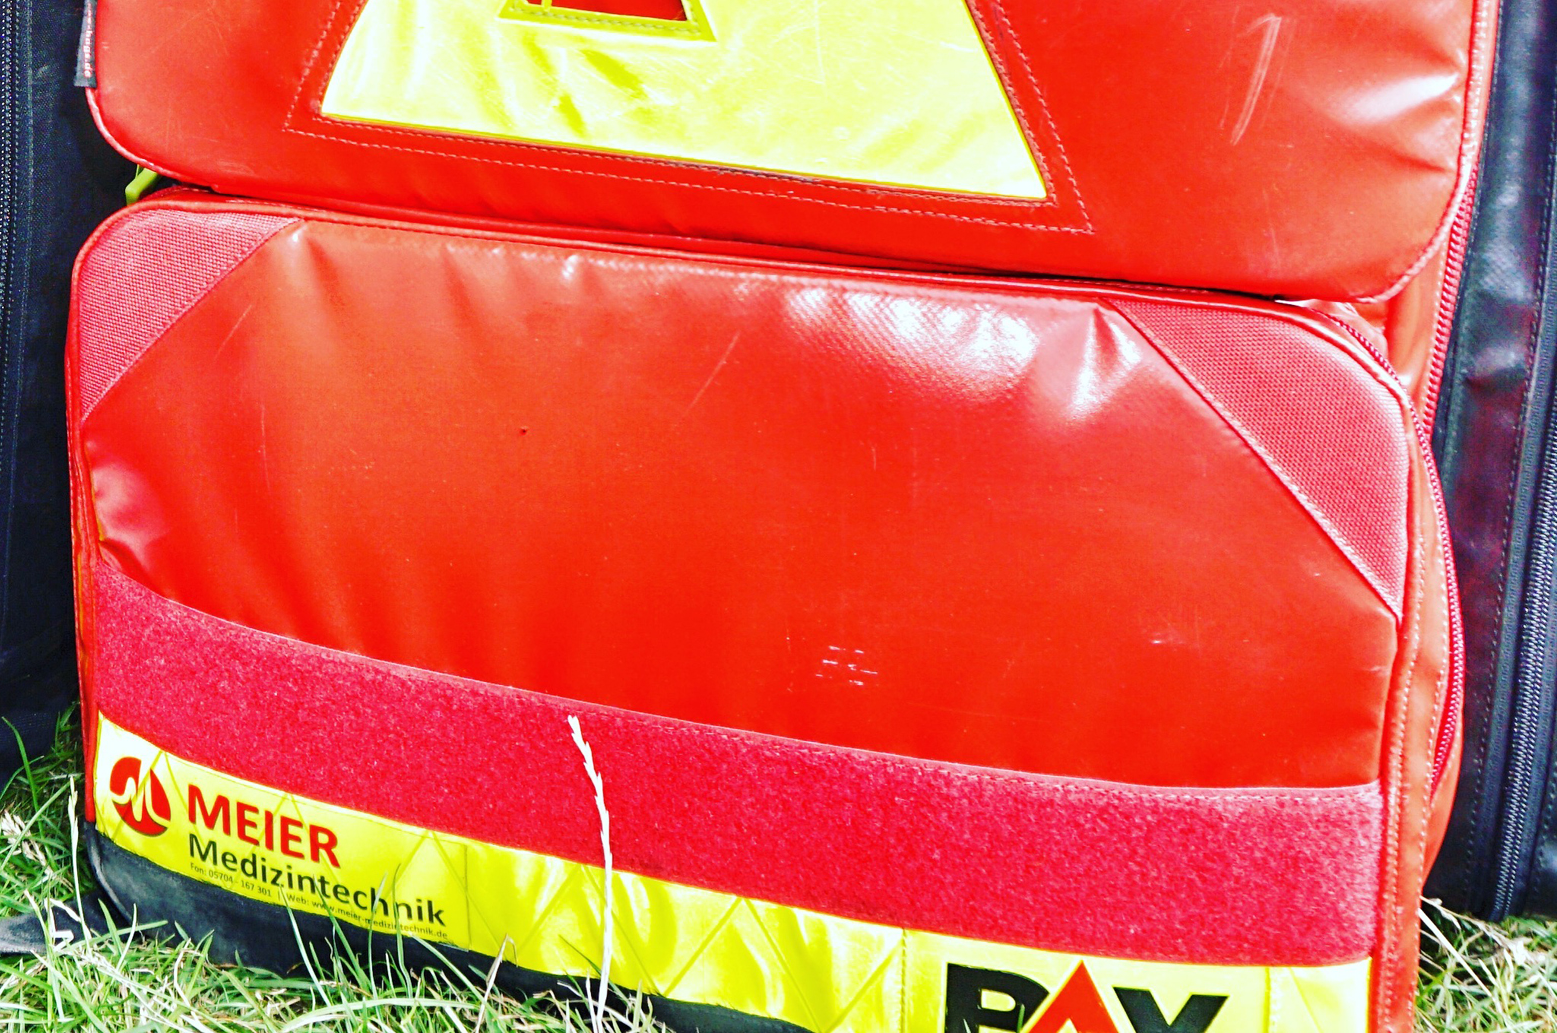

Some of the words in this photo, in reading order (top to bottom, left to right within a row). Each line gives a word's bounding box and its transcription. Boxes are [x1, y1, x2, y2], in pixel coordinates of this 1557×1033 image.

[188, 783, 341, 868] MEIER
[189, 833, 447, 927] Medizintechnik
[190, 863, 206, 876] Fon:
[241, 879, 255, 891] 167
[257, 885, 272, 897] 301
